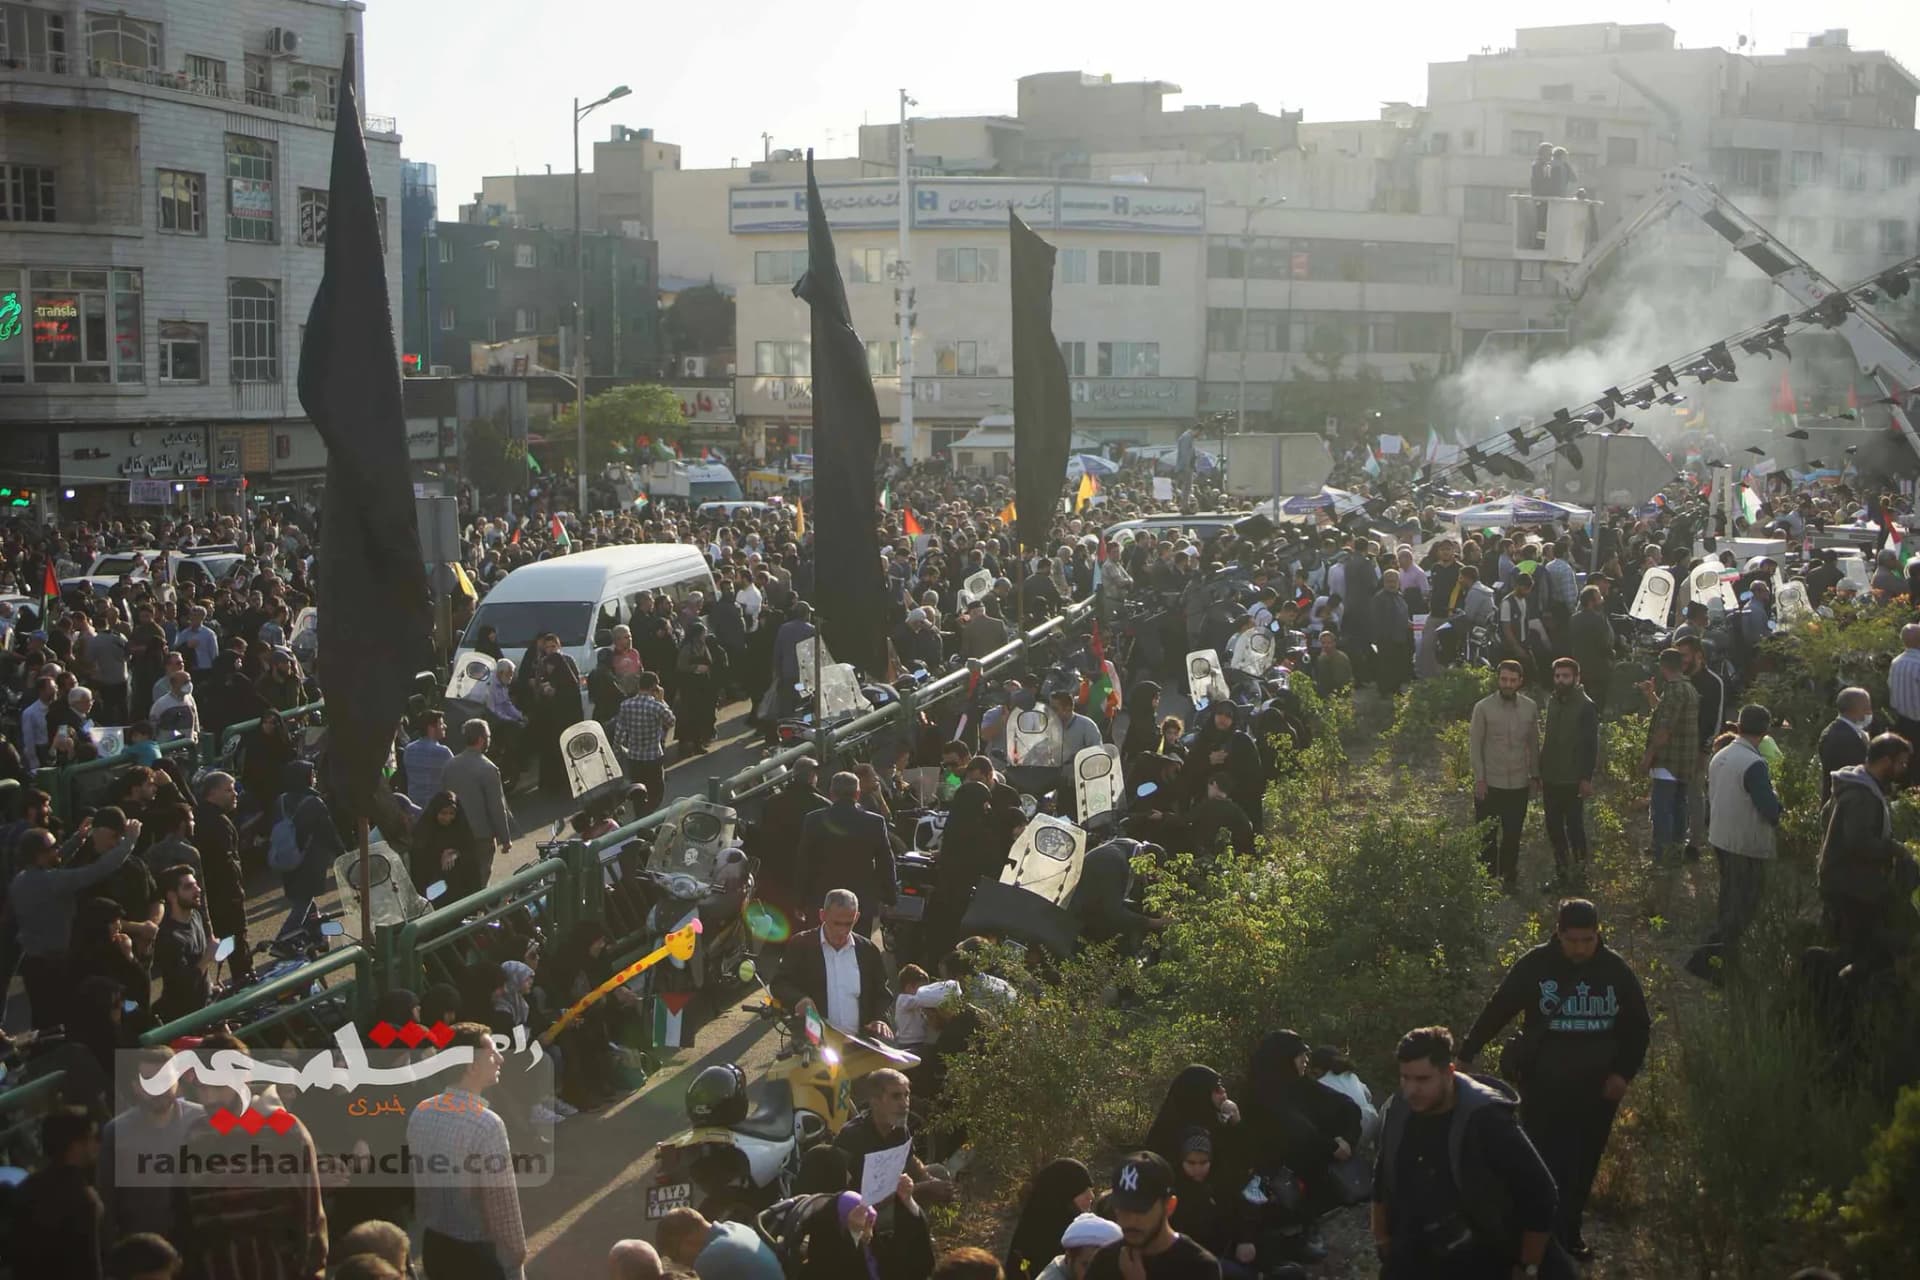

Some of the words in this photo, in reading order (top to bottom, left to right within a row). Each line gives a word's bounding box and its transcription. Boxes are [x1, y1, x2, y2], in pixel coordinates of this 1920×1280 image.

[948, 197, 978, 212] ایران
[1024, 189, 1054, 214] بانک
[121, 454, 145, 475] کتاب
[147, 454, 174, 477] تلفنی
[177, 450, 208, 475] سفارش
[1539, 979, 1620, 1017] Saint
[1549, 1019, 1610, 1031] ENEMY
